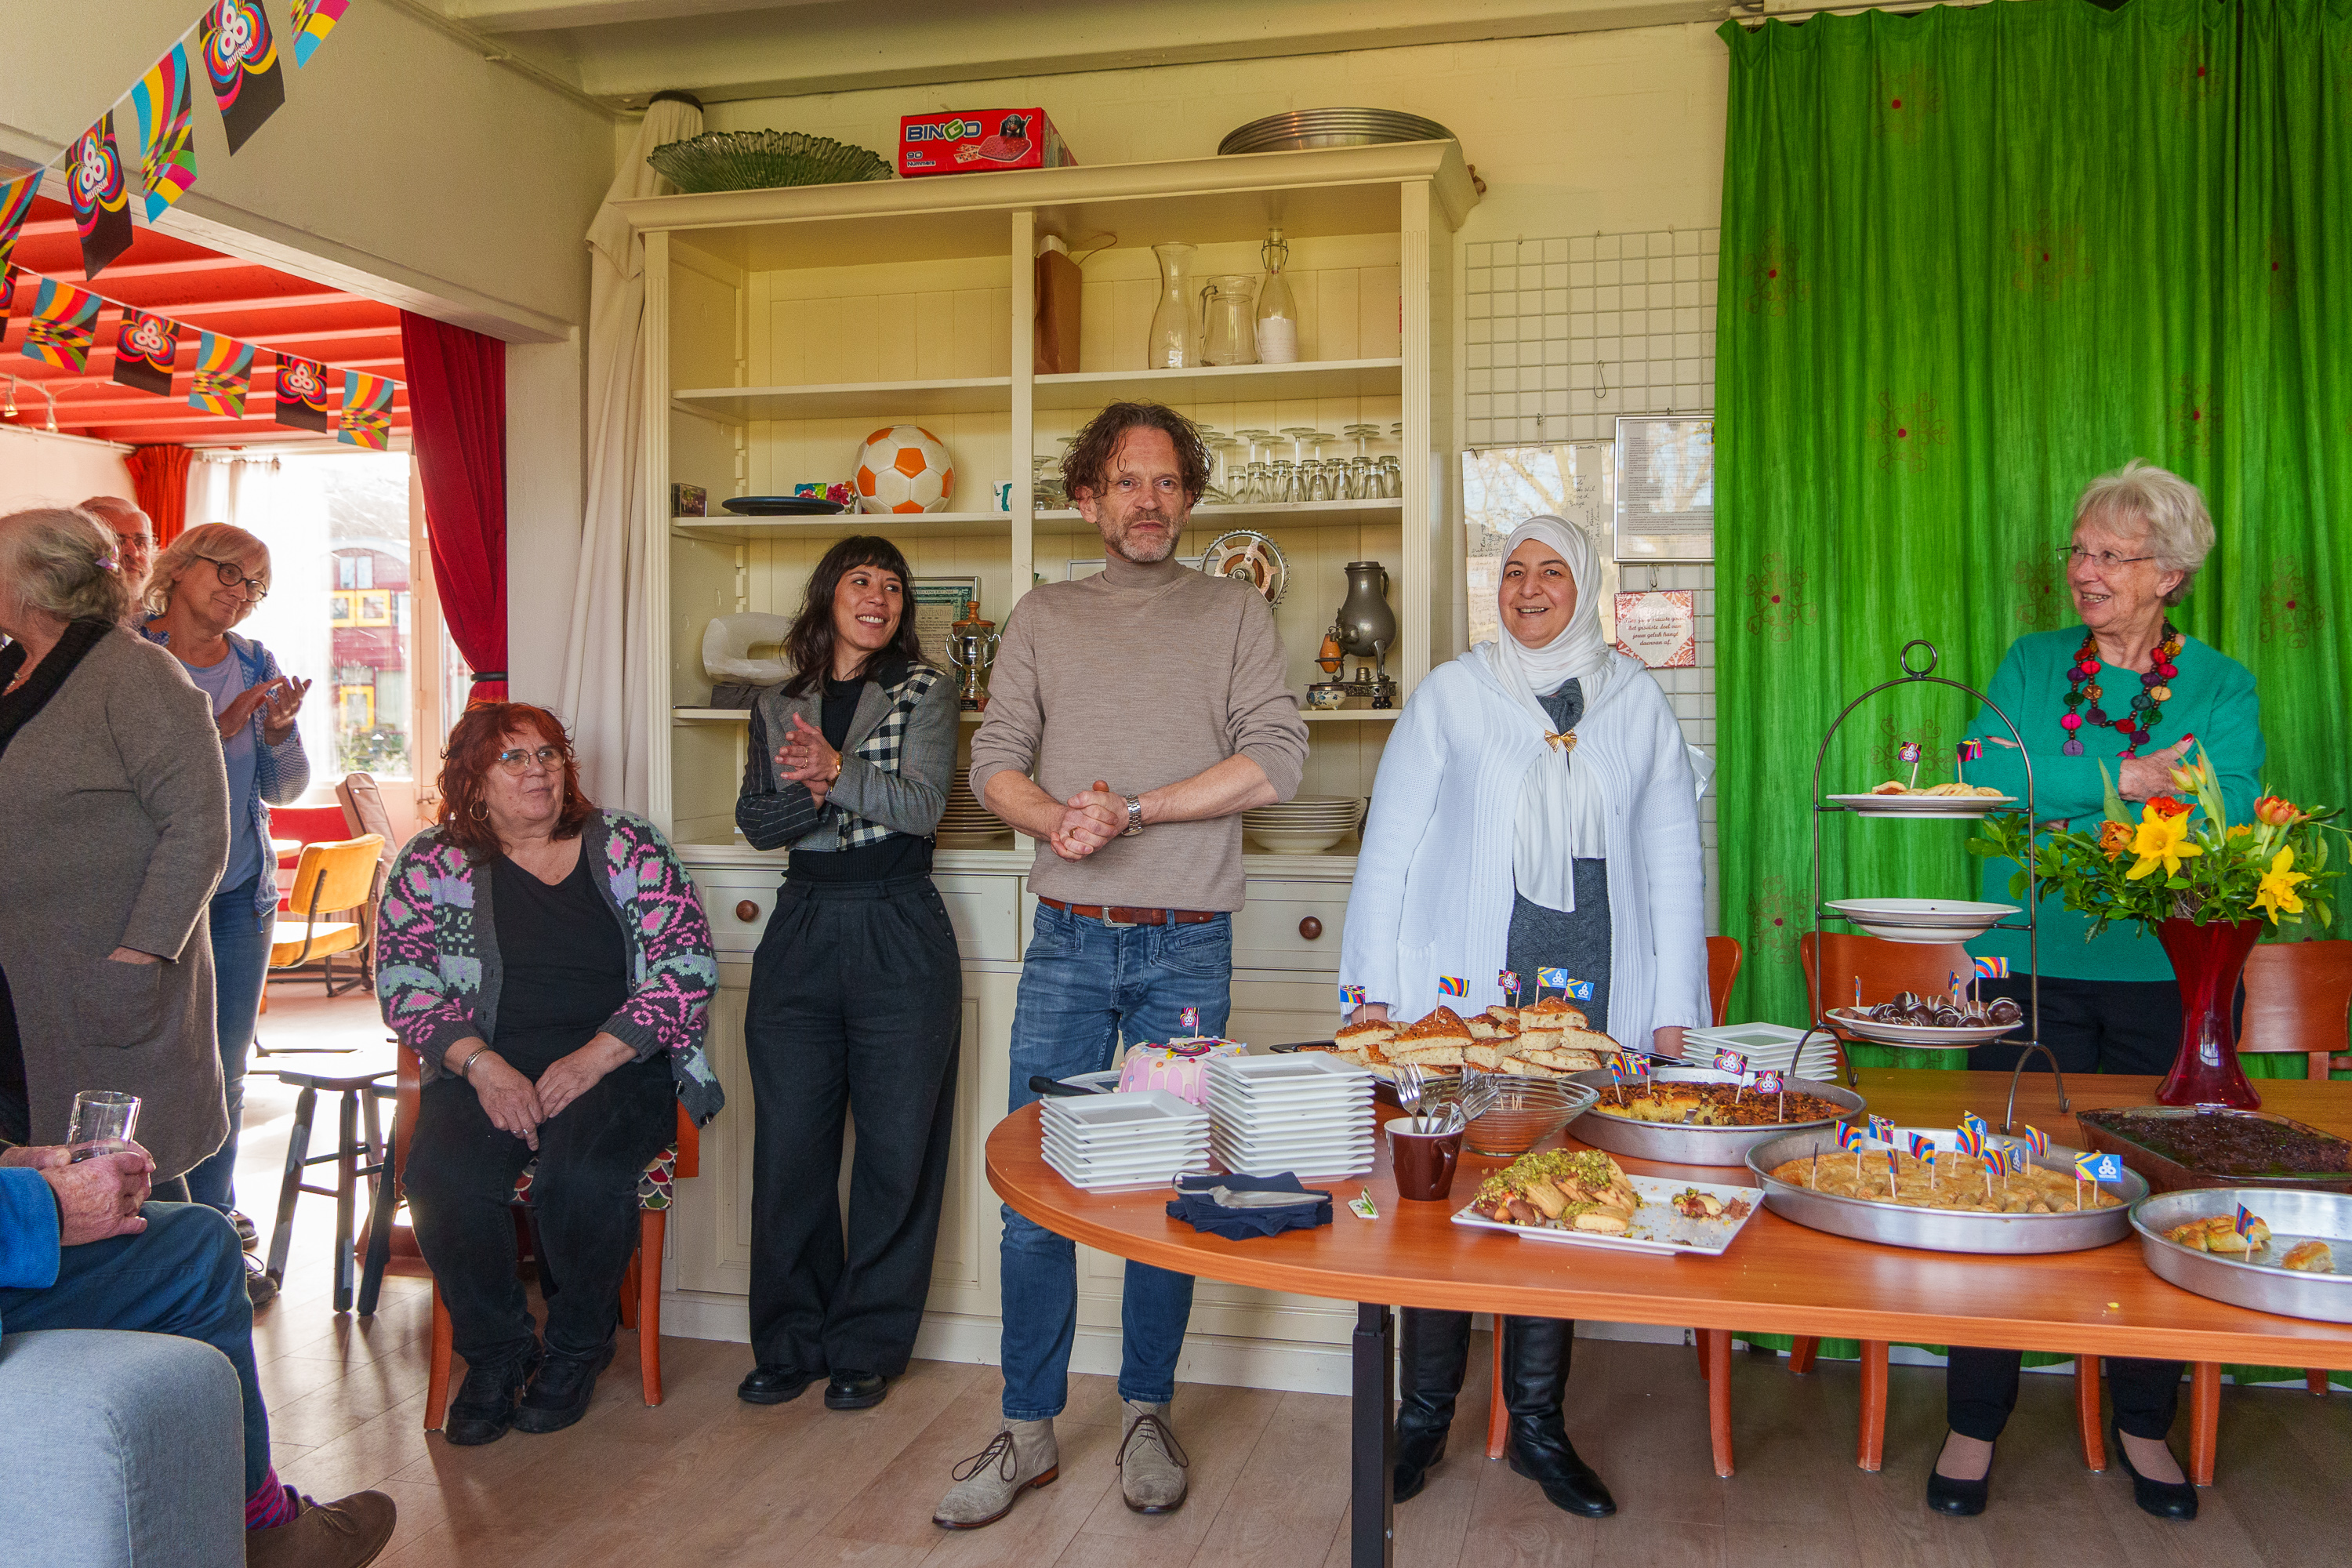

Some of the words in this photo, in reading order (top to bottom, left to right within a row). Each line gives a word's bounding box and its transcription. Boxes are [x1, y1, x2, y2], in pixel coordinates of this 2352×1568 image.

[225, 37, 253, 70] HILVERSUM
[906, 118, 982, 142] BINGO
[85, 177, 109, 202] HILVERSUM
